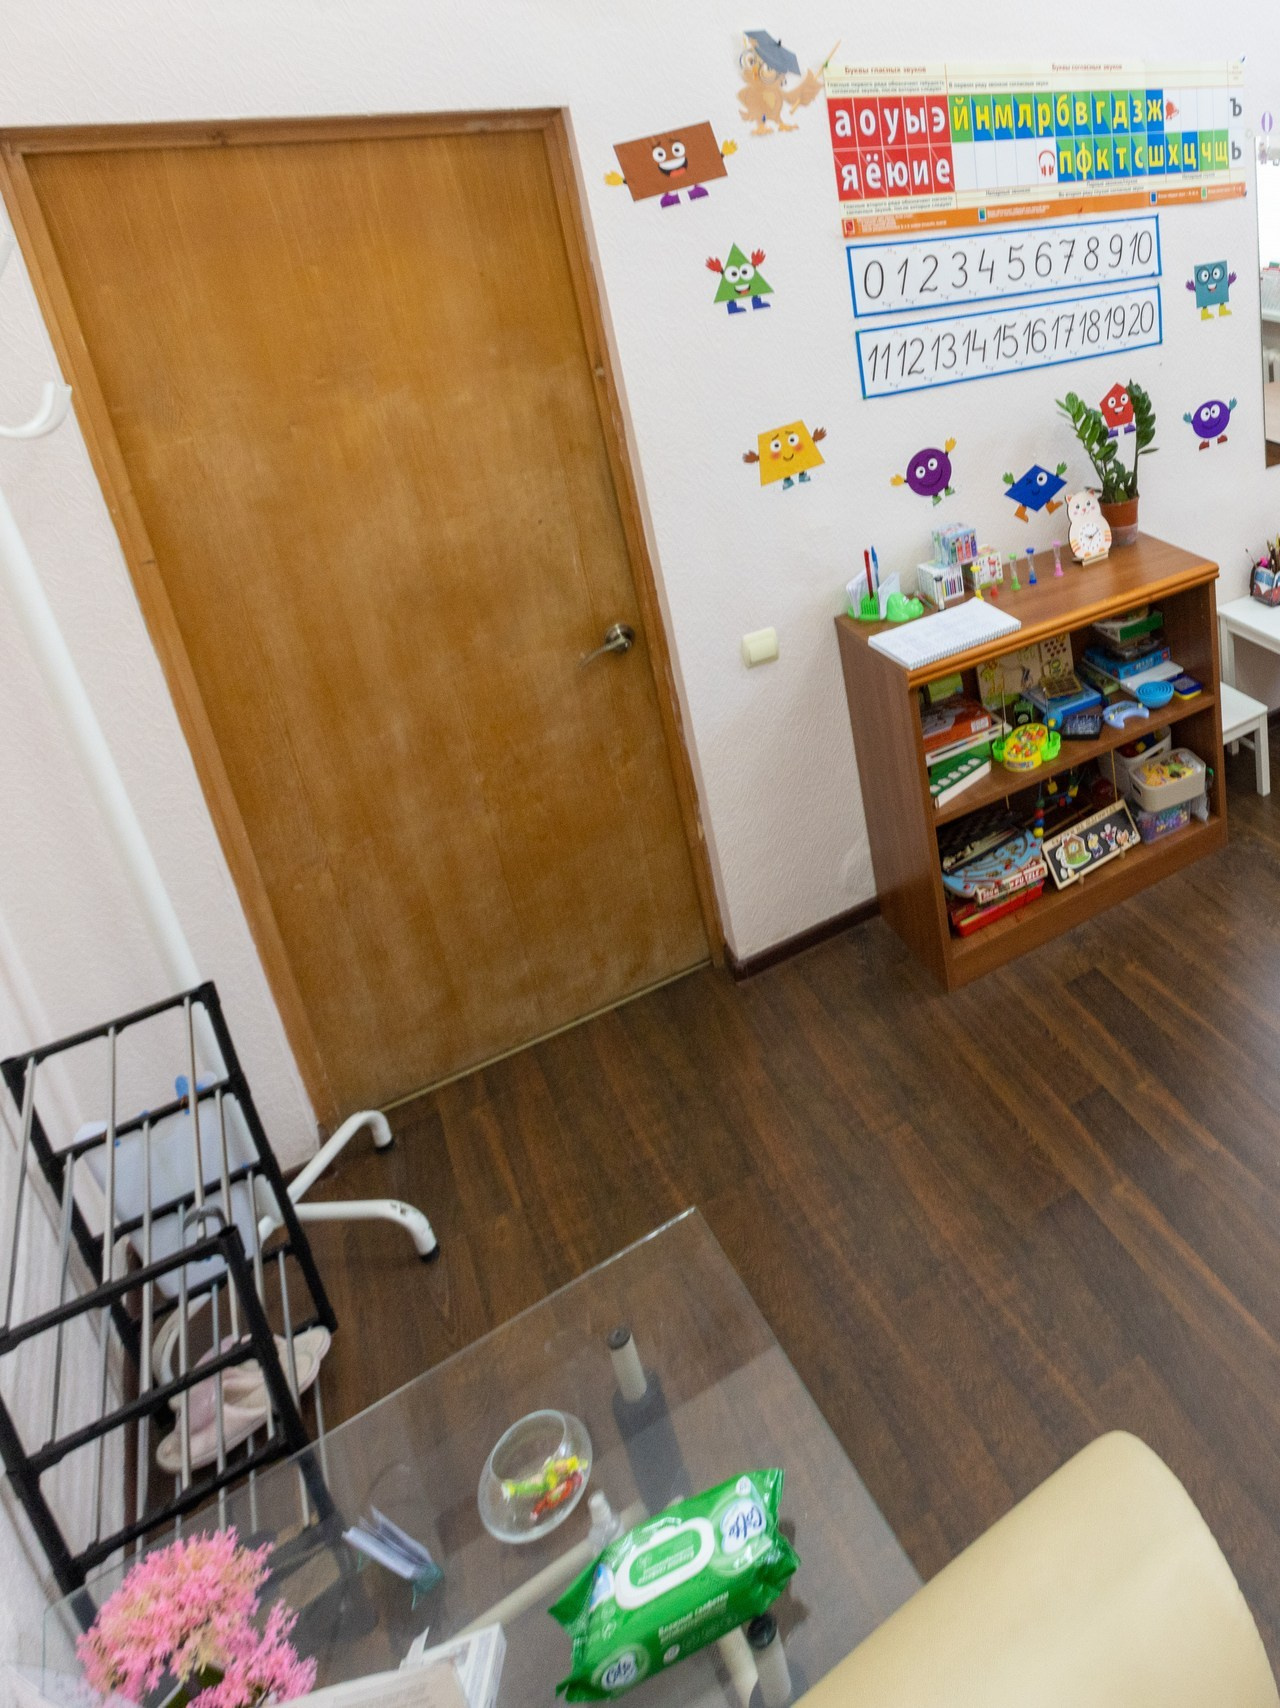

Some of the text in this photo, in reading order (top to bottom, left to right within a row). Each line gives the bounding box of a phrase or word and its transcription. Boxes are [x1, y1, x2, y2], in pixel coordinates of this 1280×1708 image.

[835, 94, 1243, 144] а о у ы э й н м л р б в г д з ж ъ
[841, 140, 1241, 191] я ё ю и е п ф к т с ш х ц ч щ ь
[864, 230, 1153, 299] 0 1 2 3 4 5 6 7 8 9 10
[868, 300, 1155, 382] 11 12 13 14 15 16 17 18 19 20
